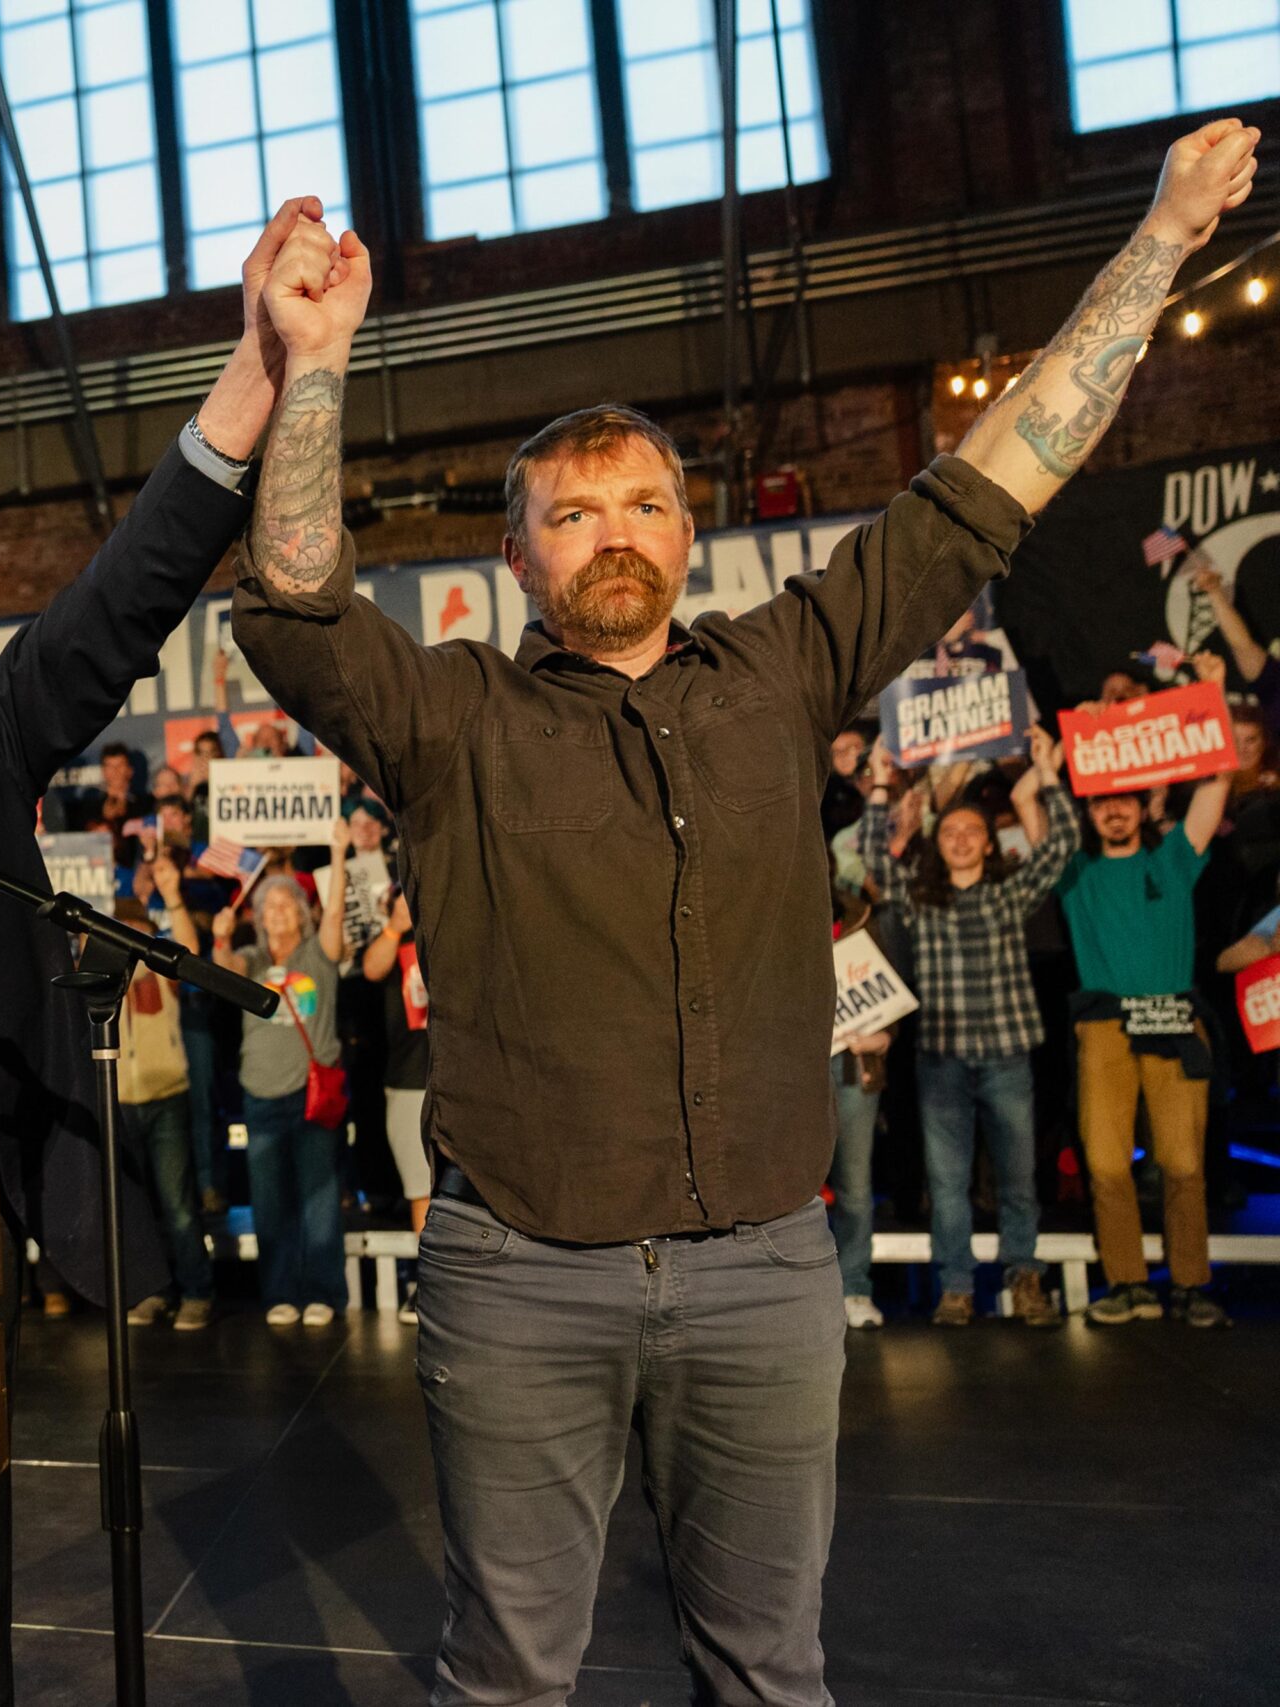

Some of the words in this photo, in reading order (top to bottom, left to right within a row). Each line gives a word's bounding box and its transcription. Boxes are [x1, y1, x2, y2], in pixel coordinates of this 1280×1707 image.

[898, 672, 1009, 724] GRAHAM
[899, 696, 1012, 751] PLATNER
[1073, 718, 1226, 776] GRAHAM
[1074, 713, 1180, 747] LABOR
[217, 795, 333, 822] GRAHAM
[834, 971, 897, 1026] HAM
